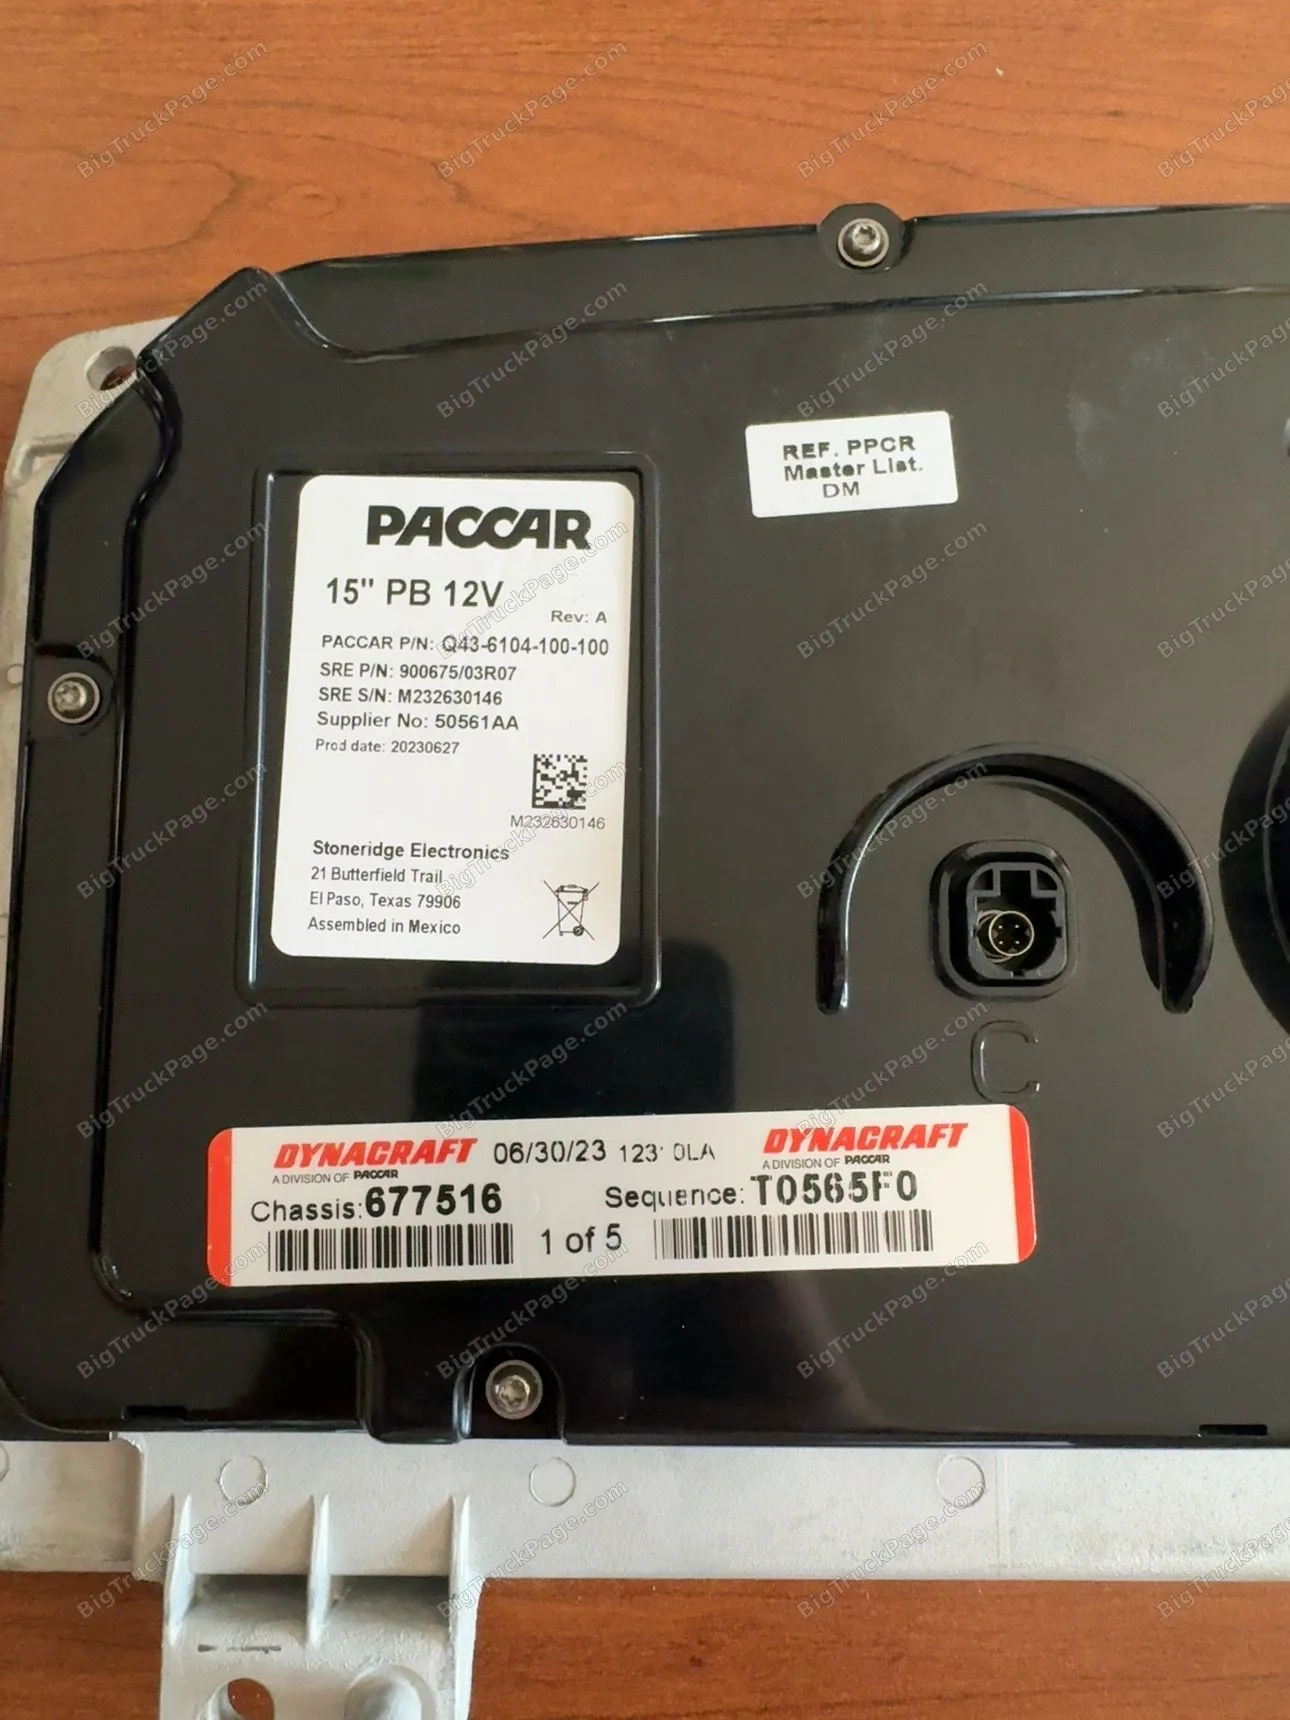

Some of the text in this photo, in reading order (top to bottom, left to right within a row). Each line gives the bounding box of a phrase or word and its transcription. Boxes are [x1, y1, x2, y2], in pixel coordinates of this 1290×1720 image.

[783, 435, 915, 460] REF. PPCR
[784, 456, 924, 481] Master List.
[822, 481, 860, 498] DM
[366, 504, 592, 550] PACCAR
[325, 577, 504, 608] 15" PB 12V
[550, 610, 608, 624] Rev: A
[321, 634, 609, 656] PACCAR P/N: Q43-6104-100-100
[319, 661, 517, 681] SRE P/N: 900675/03R07
[318, 686, 503, 706] SRE S/N: M232630146
[317, 711, 520, 731] Supplier No: 50561AA
[315, 738, 461, 755] Prod date: 20230627
[510, 814, 606, 830] M232630146
[313, 839, 510, 861] Stoneridge Electronics
[311, 866, 444, 884] 21 Butterfield Trail
[309, 891, 461, 910] El Paso, Texas 79906
[307, 916, 461, 935] Assembled in Mexico
[762, 1122, 969, 1154] DYNACRAFT
[273, 1137, 478, 1169] DYNACRAFT
[493, 1139, 716, 1164] 06/30/23 1230LA
[762, 1153, 891, 1170] A DIVISION OF PACCAR
[272, 1169, 400, 1185] A DIVISION OF PACCAR
[365, 1182, 503, 1218] 677516
[605, 1185, 745, 1212] Sequence:
[540, 1223, 623, 1255] 1 of 5
